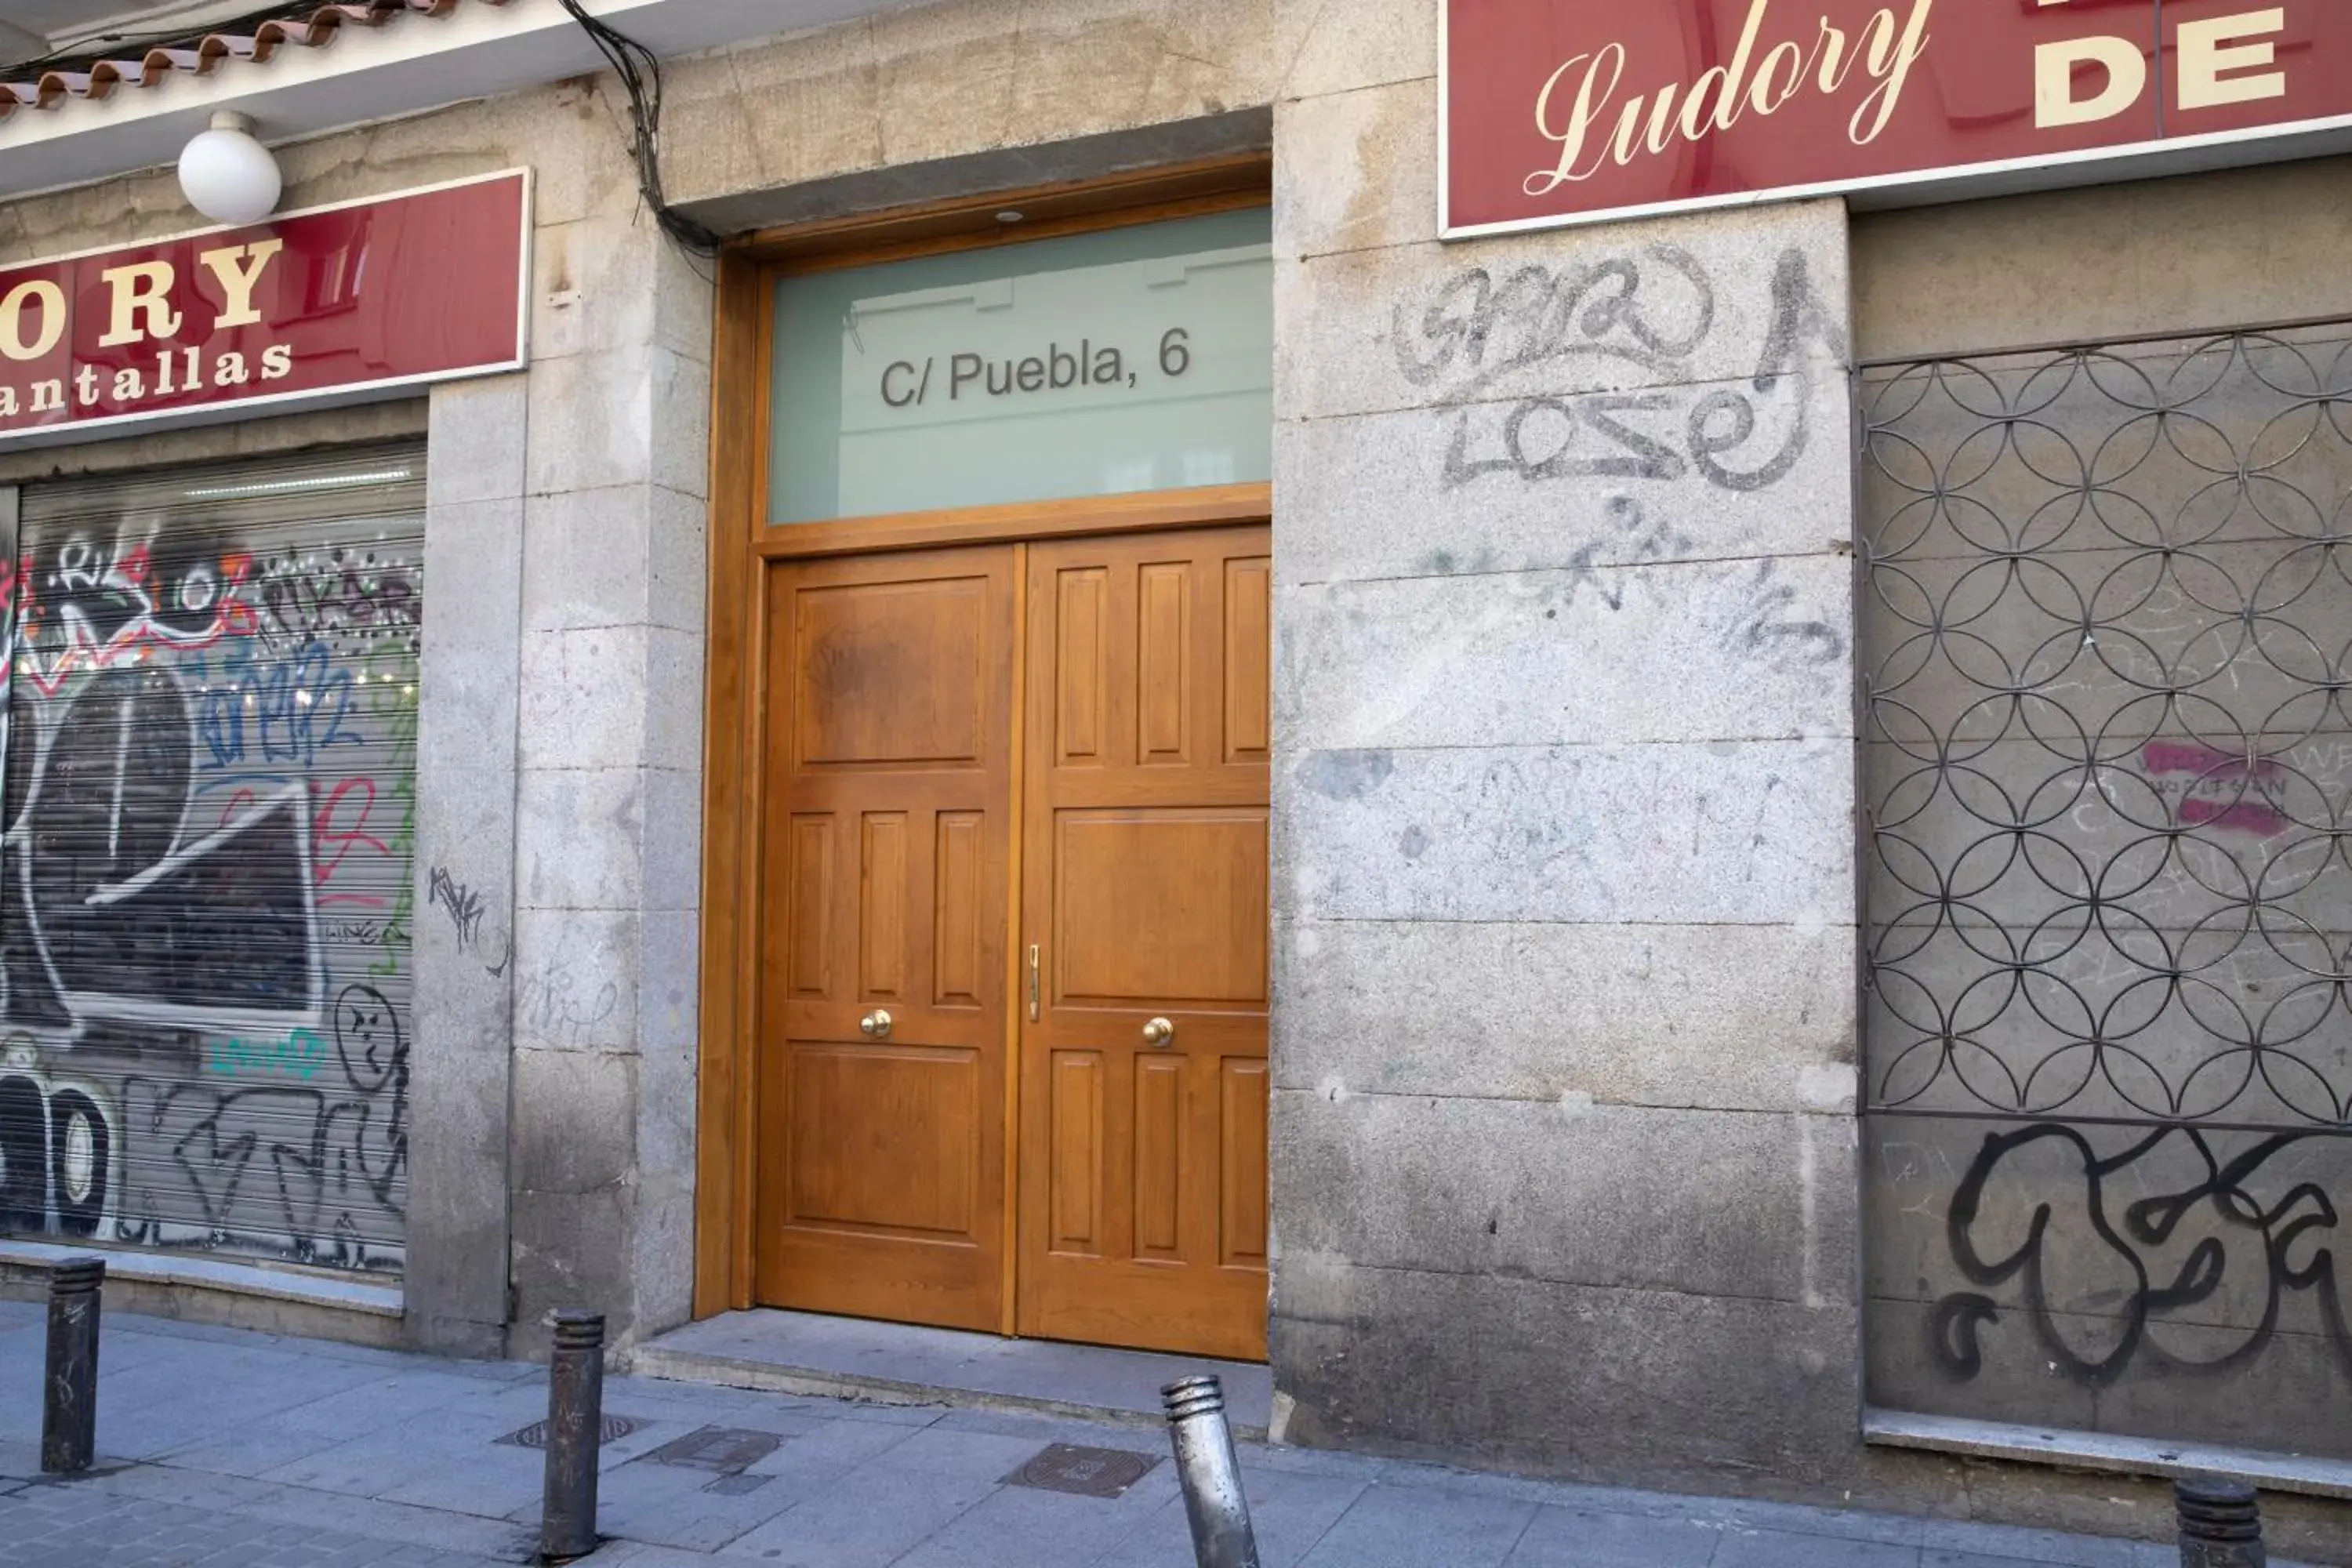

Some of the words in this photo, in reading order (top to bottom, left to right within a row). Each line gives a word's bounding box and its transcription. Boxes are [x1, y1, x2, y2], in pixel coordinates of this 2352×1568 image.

[1523, 0, 1930, 196] Ludory
[2034, 7, 2285, 129] DE
[0, 238, 283, 361] ORY
[880, 356, 933, 407] C/
[949, 338, 1136, 401] Puebla,
[1159, 327, 1190, 376] 6
